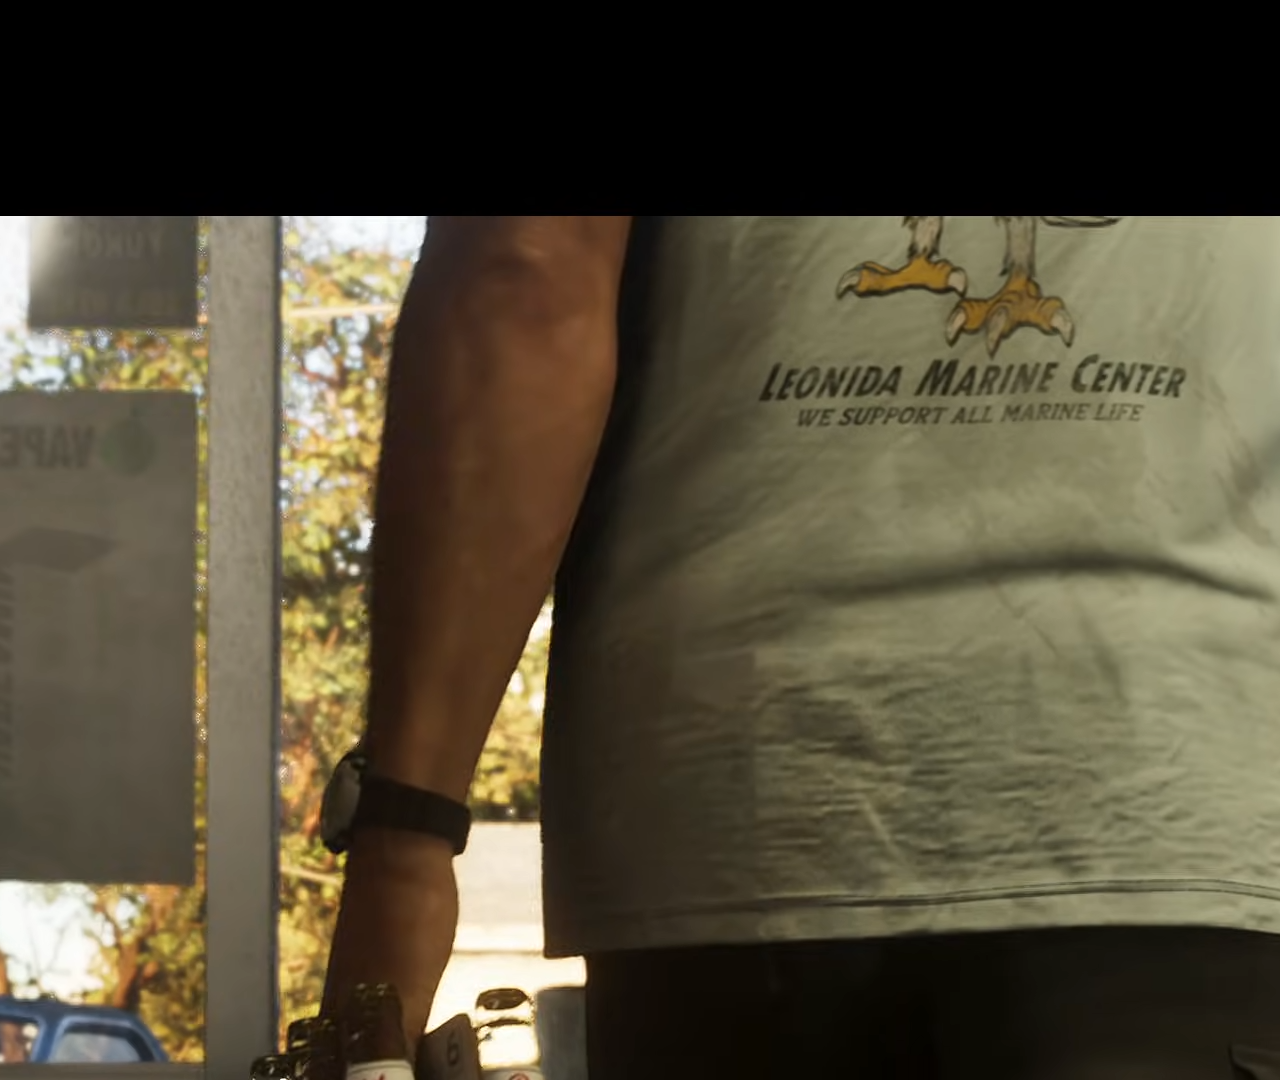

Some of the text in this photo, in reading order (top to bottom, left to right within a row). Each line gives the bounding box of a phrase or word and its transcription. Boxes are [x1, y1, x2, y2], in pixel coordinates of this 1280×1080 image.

[759, 354, 1188, 402] LEONIDA MARINE CENTER
[796, 402, 1146, 428] WE SUPPORT ALL MARINE LIFE
